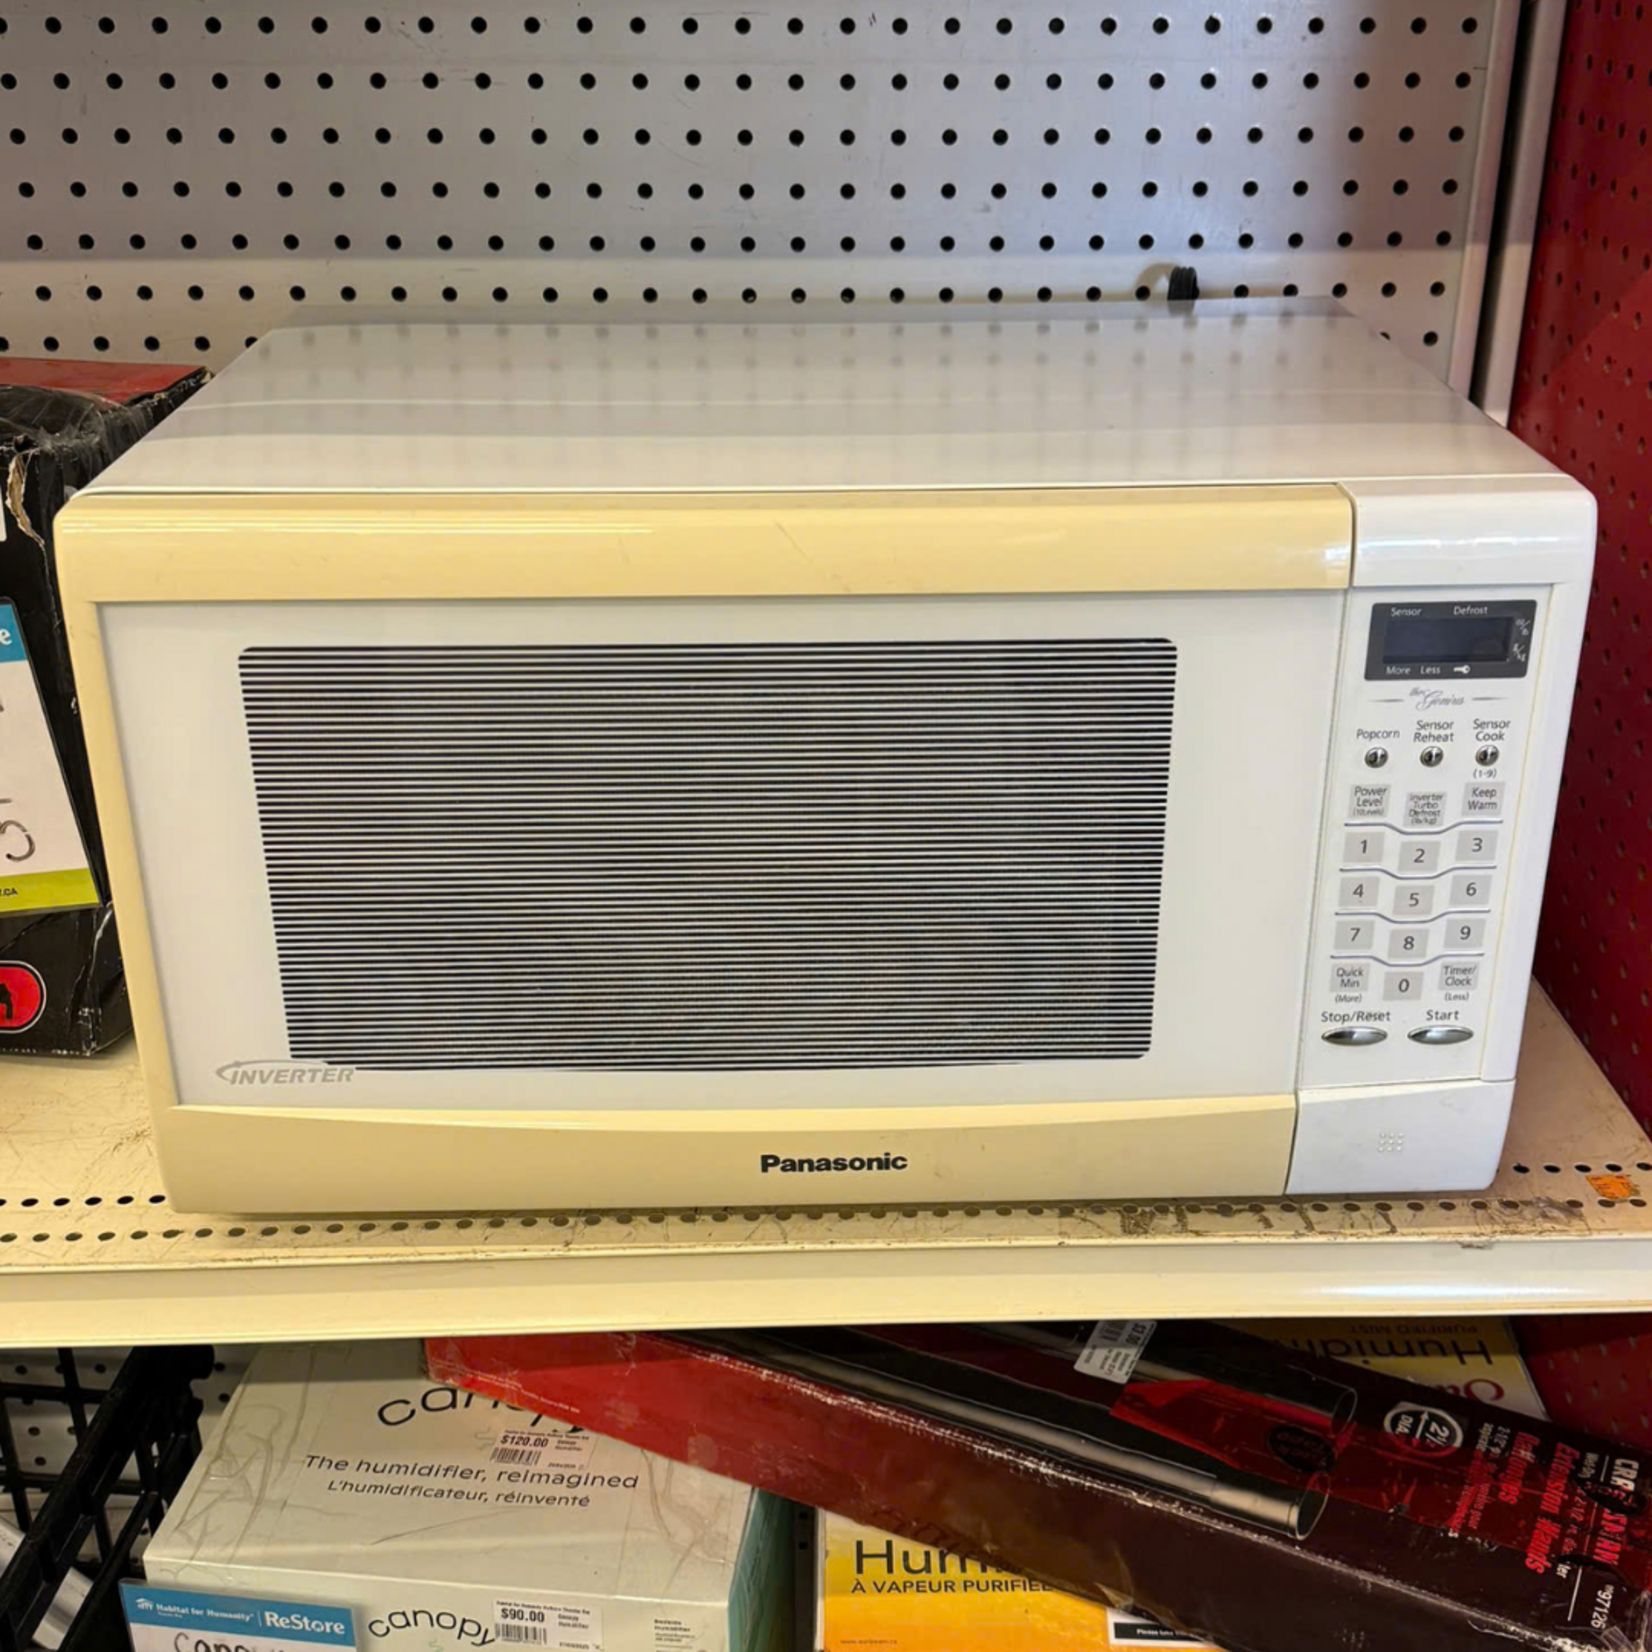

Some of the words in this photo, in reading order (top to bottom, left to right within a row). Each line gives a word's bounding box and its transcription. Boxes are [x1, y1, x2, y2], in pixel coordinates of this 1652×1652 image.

[1390, 606, 1422, 617] Sensor
[1453, 605, 1489, 616] Defrost
[1385, 665, 1412, 676] More
[1420, 664, 1442, 675] Less
[1415, 719, 1455, 731] Sensor
[1473, 718, 1512, 731] Sensor
[1356, 728, 1401, 742] Popcorn
[1412, 731, 1455, 743] Reheat
[1474, 730, 1506, 742] Cook
[1472, 768, 1498, 779] (1-9)
[1353, 785, 1388, 797] Power
[1470, 786, 1498, 798] Keep
[1356, 796, 1384, 808] Level
[1413, 800, 1440, 810] Turbo
[1467, 799, 1499, 811] Warm
[1408, 808, 1442, 818] Defrost
[1360, 839, 1368, 855] 1
[1471, 837, 1483, 853] 3
[1413, 848, 1425, 864] 2
[1352, 883, 1365, 899] 4
[1466, 881, 1477, 897] 6
[1408, 892, 1420, 908] 5
[1349, 927, 1361, 942] 7
[1459, 924, 1472, 941] 9
[1402, 935, 1415, 951] 8
[1336, 967, 1364, 978] Quick
[1443, 964, 1476, 976] Timer/
[1339, 977, 1361, 988] Min
[1398, 978, 1410, 994] 0
[1445, 975, 1472, 987] Clock
[1334, 993, 1363, 1004] (More)
[1443, 991, 1470, 1002] (Less)
[1320, 1010, 1392, 1026] Stop/Reset
[1425, 1008, 1460, 1022] Start
[229, 1067, 355, 1086] INVERTER
[760, 1151, 909, 1174] Panasonic
[500, 1434, 549, 1449] $120.00
[304, 1453, 350, 1473] The
[356, 1456, 488, 1484] humidifier,
[496, 1466, 640, 1490] reimagined
[1540, 1441, 1580, 1515] Extension
[494, 1489, 591, 1508] réinventé
[1524, 1517, 1562, 1574] Wands
[850, 1578, 867, 1594] À
[872, 1580, 957, 1594] VAPEUR
[156, 1602, 190, 1615] Habitat
[190, 1607, 205, 1617] for
[205, 1609, 251, 1622] Humanity
[263, 1610, 346, 1635] ReStore
[501, 1607, 545, 1623] $90.00
[368, 1608, 495, 1647] canopy
